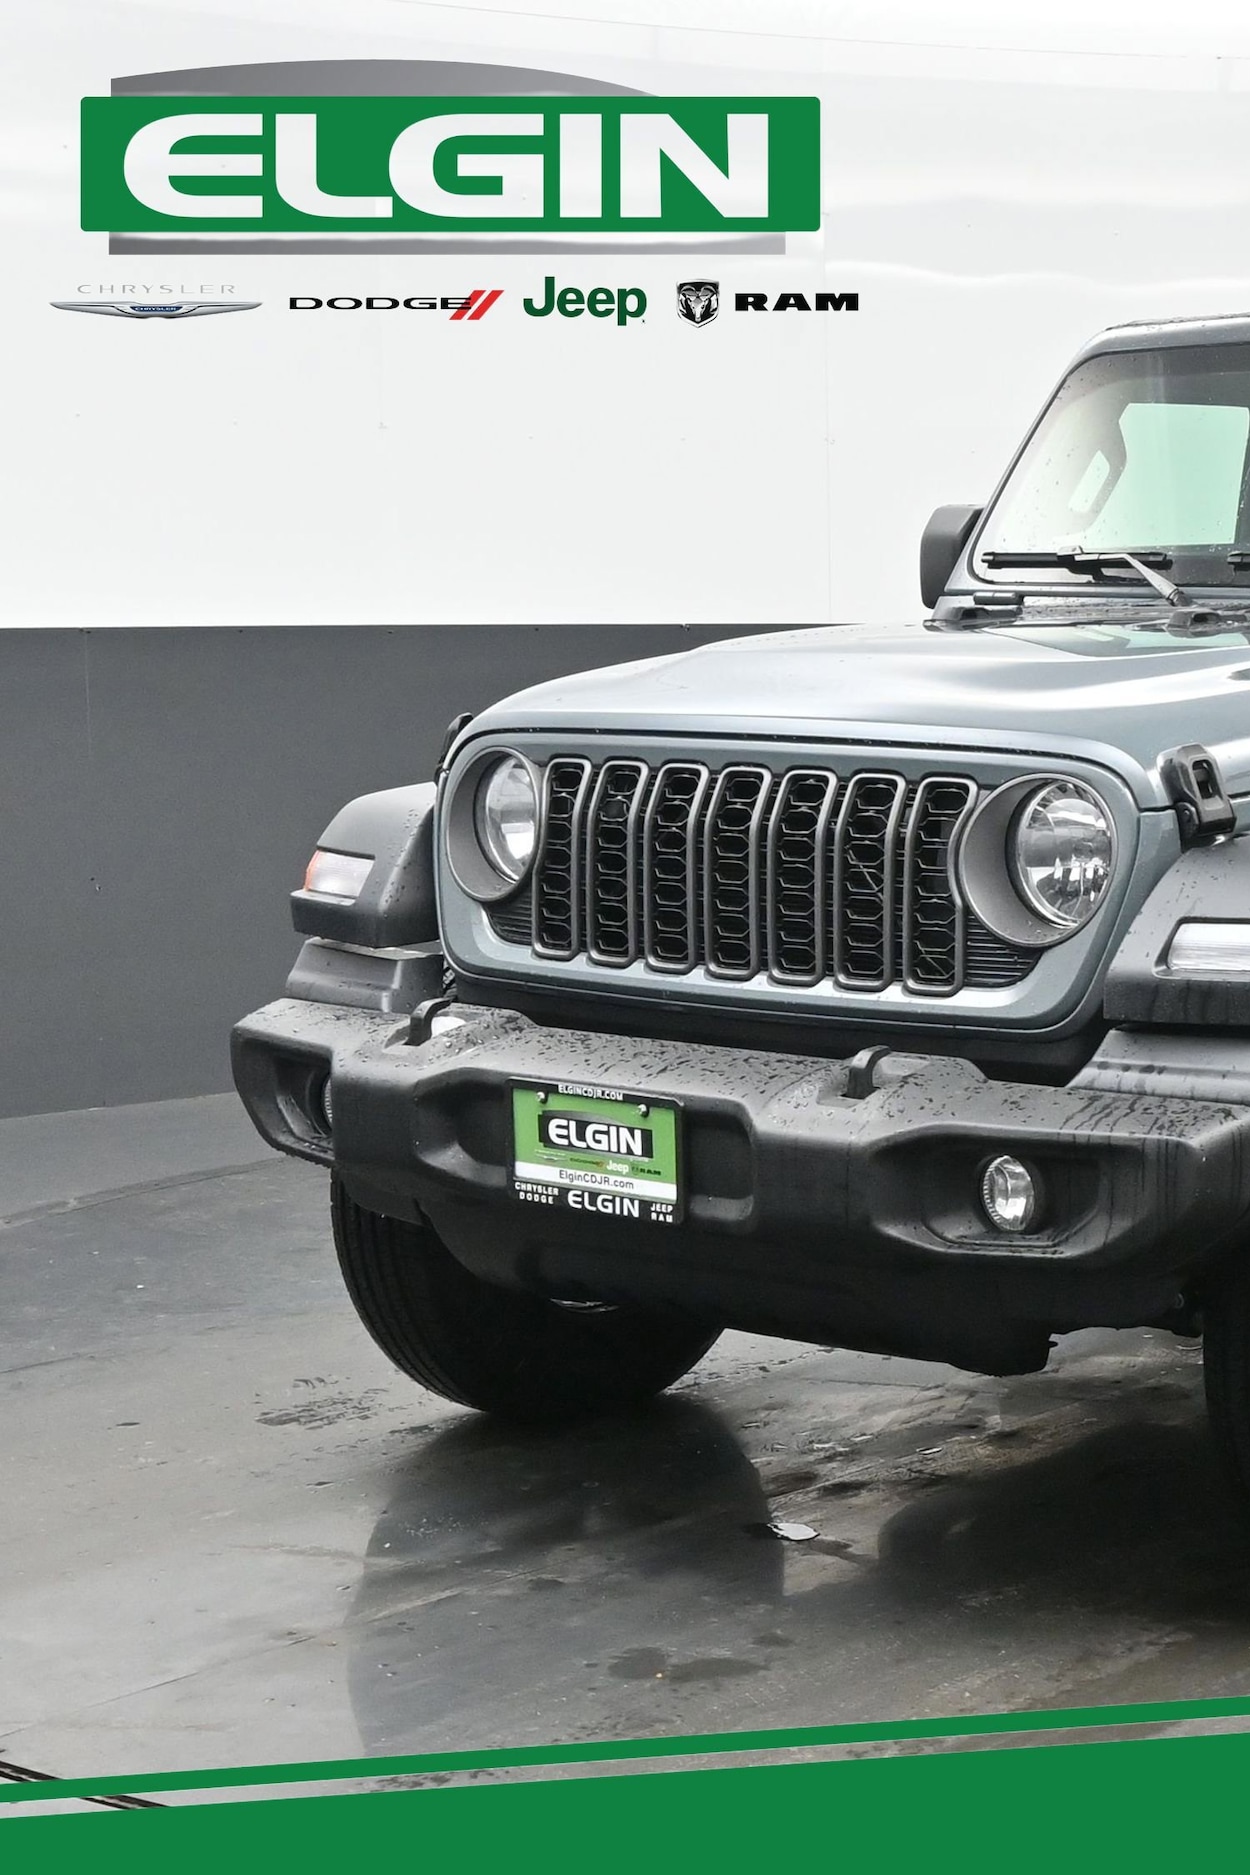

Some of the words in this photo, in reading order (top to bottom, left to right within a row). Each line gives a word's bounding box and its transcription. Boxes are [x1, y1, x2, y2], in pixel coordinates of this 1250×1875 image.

[557, 1084, 624, 1101] ELGINCDJR.COM
[547, 1117, 643, 1156] ELGIN
[606, 1160, 629, 1175] Jeep
[559, 1169, 635, 1190] ElginCDJR.com
[514, 1181, 560, 1196] CHRYSLER
[519, 1191, 555, 1205] DODGE
[567, 1189, 640, 1218] ELGIN
[650, 1202, 674, 1214] JEEP
[650, 1211, 674, 1223] RAM
